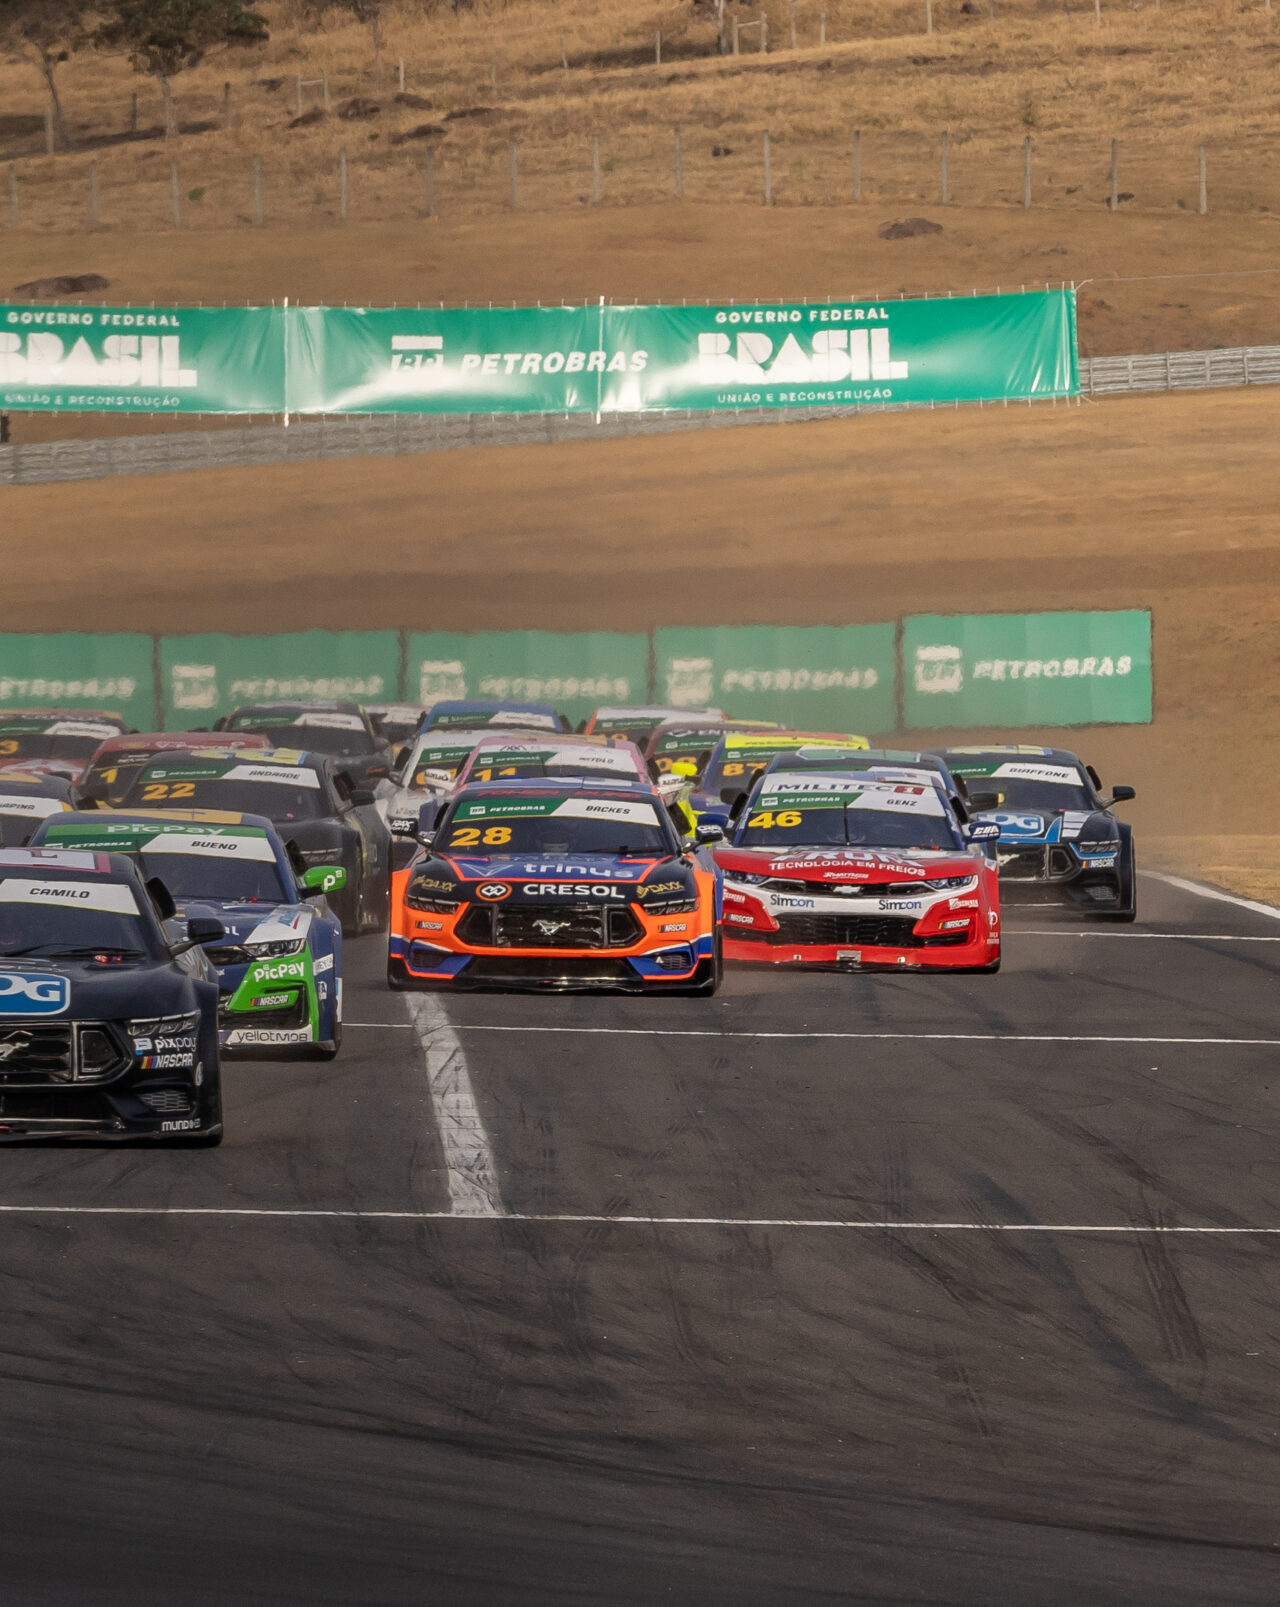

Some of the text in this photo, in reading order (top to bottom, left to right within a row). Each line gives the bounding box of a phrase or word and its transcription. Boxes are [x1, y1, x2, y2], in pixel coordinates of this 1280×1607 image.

[7, 312, 180, 327] GOVERNO FEDERAL
[715, 307, 889, 324] GOVERNO FEDERAL
[461, 351, 648, 375] PETROBRAS
[697, 327, 908, 385] BRASIL
[717, 388, 892, 404] UNIÃO E RECONSTRUÇÃO
[973, 656, 1132, 681] PETROBRAS
[723, 762, 768, 776] 87
[142, 783, 196, 800] 22
[777, 783, 893, 793] MILITEC
[585, 805, 631, 815] BACKES
[886, 799, 918, 807] GENZ
[747, 811, 803, 829] 46
[107, 824, 226, 837] PicPay
[449, 827, 513, 847] 28
[68, 840, 238, 851] PETROBRAS BUENO
[523, 863, 633, 878] trinus
[769, 860, 854, 871] TECNOLOGIA
[856, 861, 876, 869] EM
[879, 863, 926, 876] FREIOS
[1090, 859, 1114, 868] NASCAR
[29, 887, 91, 899] CAMILO
[523, 884, 626, 899] CRESOL
[770, 893, 815, 909] Simcon
[878, 898, 923, 910] Simcon
[422, 921, 443, 930] NASCAR
[663, 923, 688, 932] NASCAR
[254, 962, 305, 982] PicPay
[260, 995, 288, 1006] NASCAR
[154, 1036, 197, 1053] pixpay
[155, 1053, 193, 1068] NASCAR
